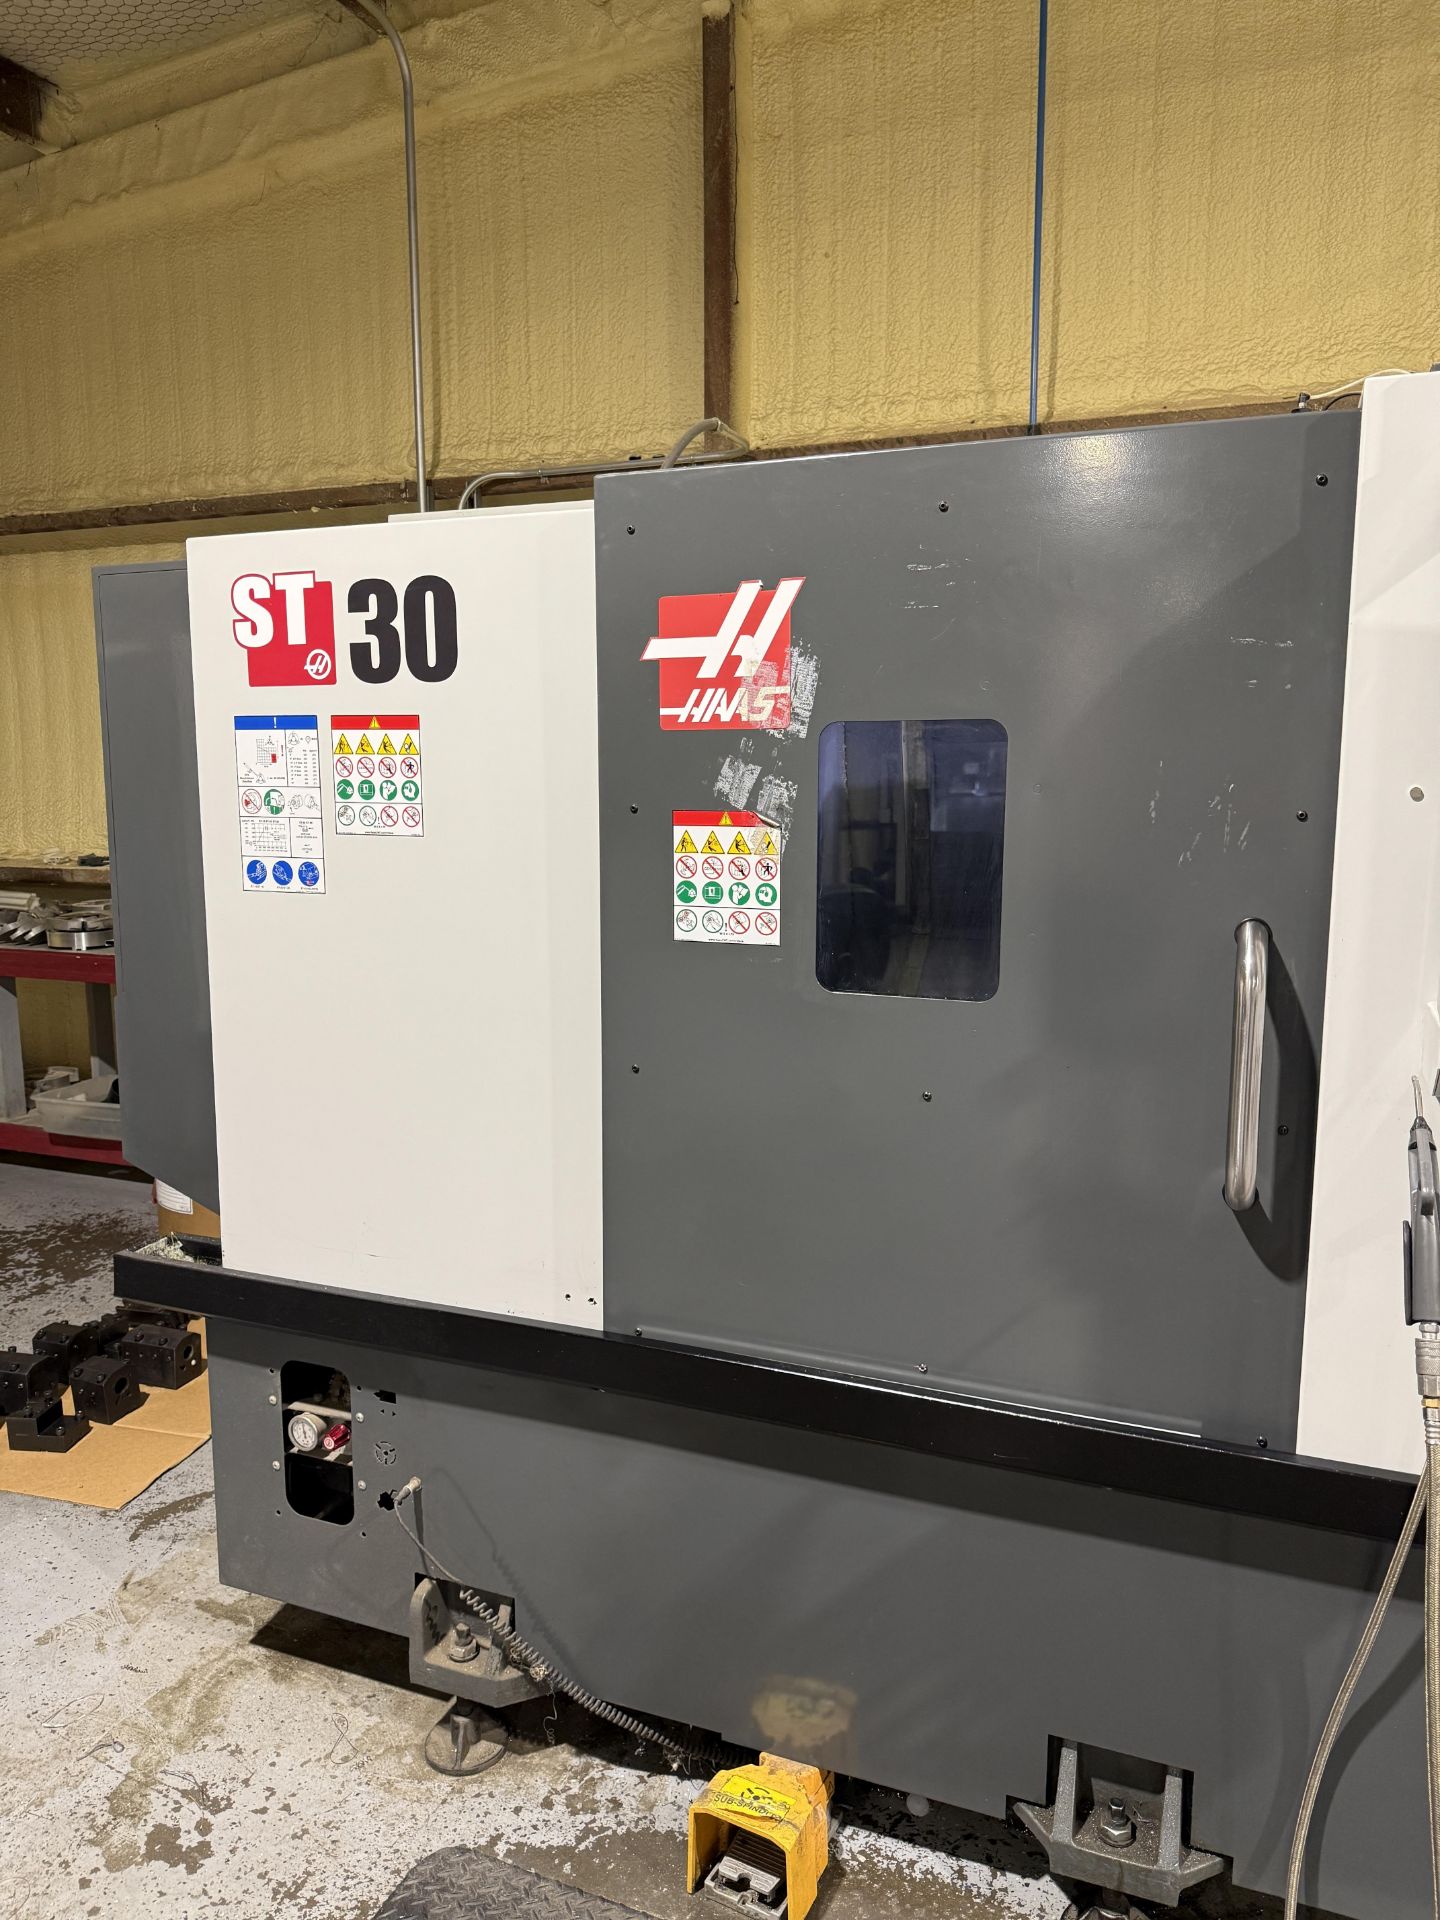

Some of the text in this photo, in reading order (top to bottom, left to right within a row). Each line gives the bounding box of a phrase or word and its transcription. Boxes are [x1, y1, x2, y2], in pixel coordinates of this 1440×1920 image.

[231, 571, 459, 685] ST 30
[660, 686, 791, 723] HAAS
